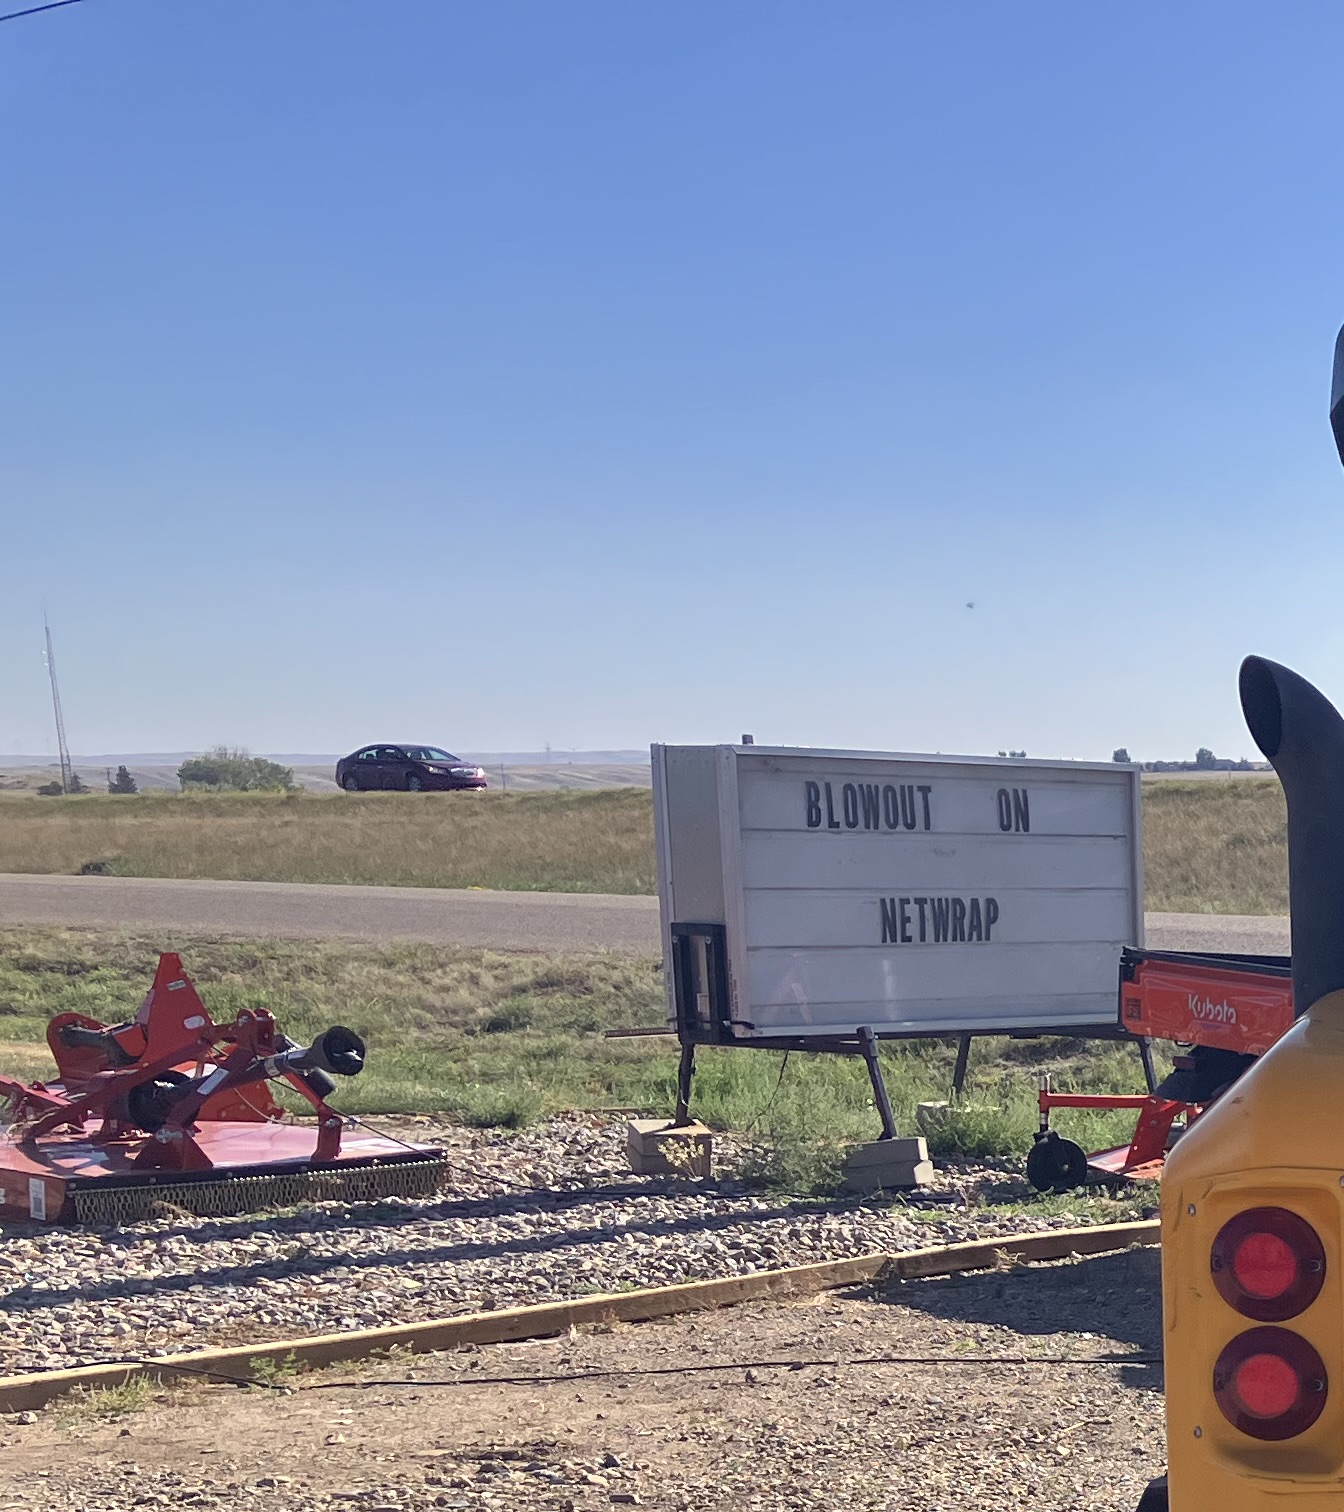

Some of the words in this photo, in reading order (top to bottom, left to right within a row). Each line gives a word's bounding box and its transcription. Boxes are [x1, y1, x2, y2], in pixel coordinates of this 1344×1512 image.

[804, 780, 932, 831] BLOWOUT
[996, 787, 1031, 833] ON
[879, 896, 1000, 944] NETWRAP
[1188, 993, 1237, 1025] Kubota
